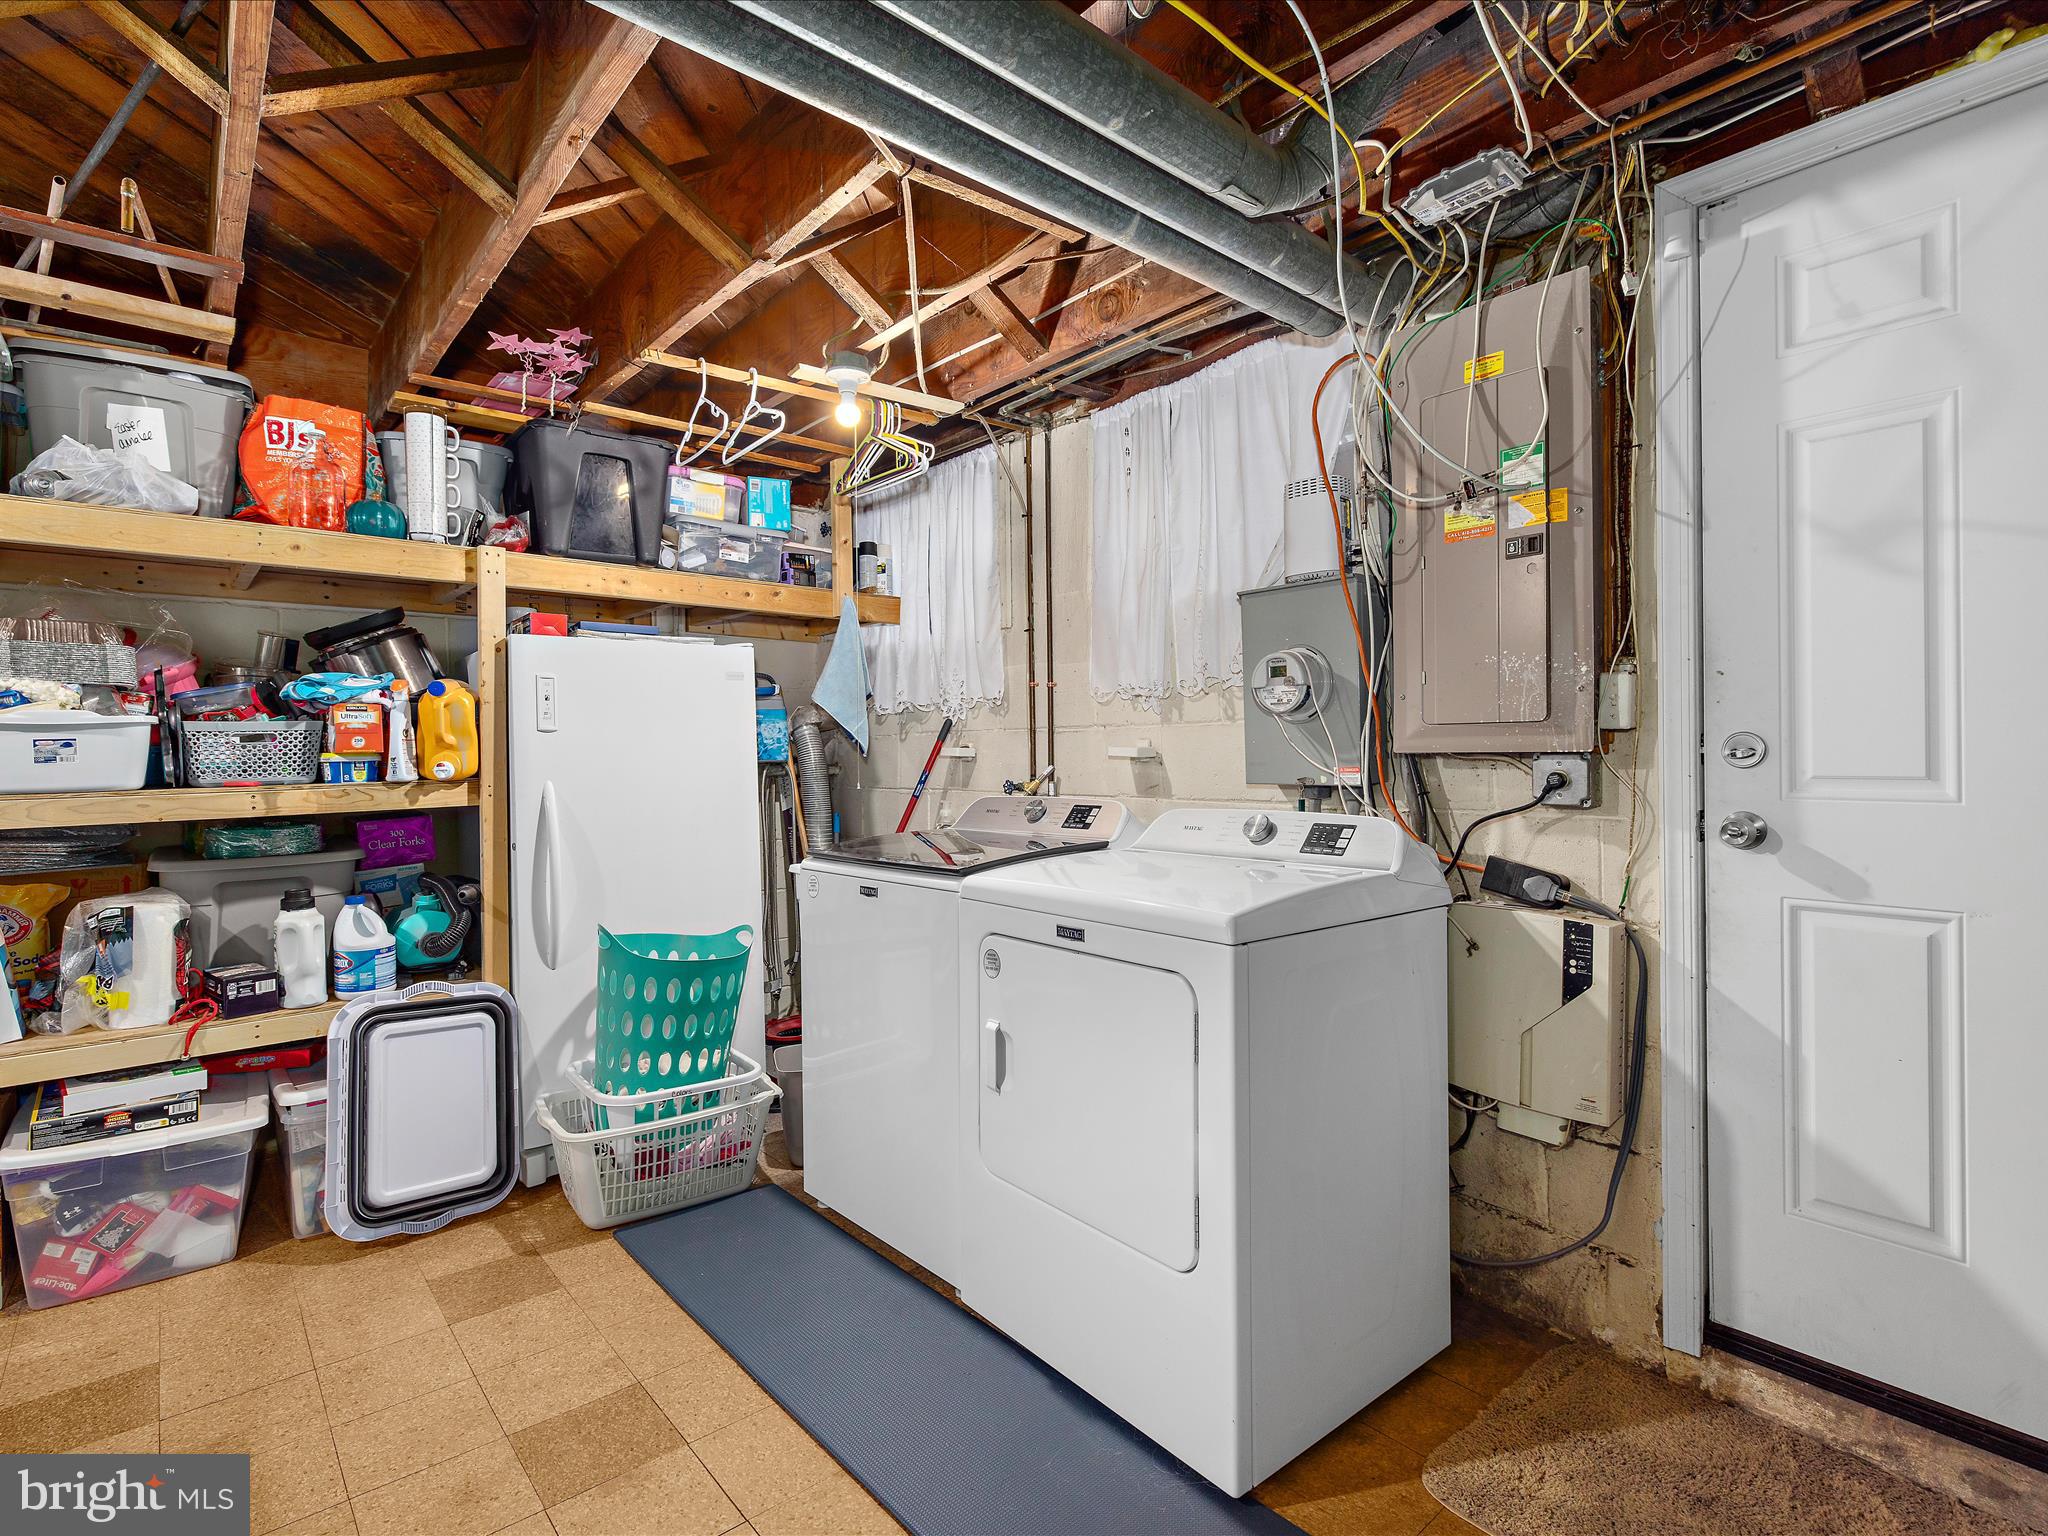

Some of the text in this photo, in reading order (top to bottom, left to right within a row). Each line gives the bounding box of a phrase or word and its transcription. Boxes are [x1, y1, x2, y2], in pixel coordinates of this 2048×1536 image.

[389, 829, 405, 838] 300
[368, 835, 426, 851] Clear Forks
[364, 878, 394, 891] FORKS
[1057, 927, 1083, 939] MAYTAG
